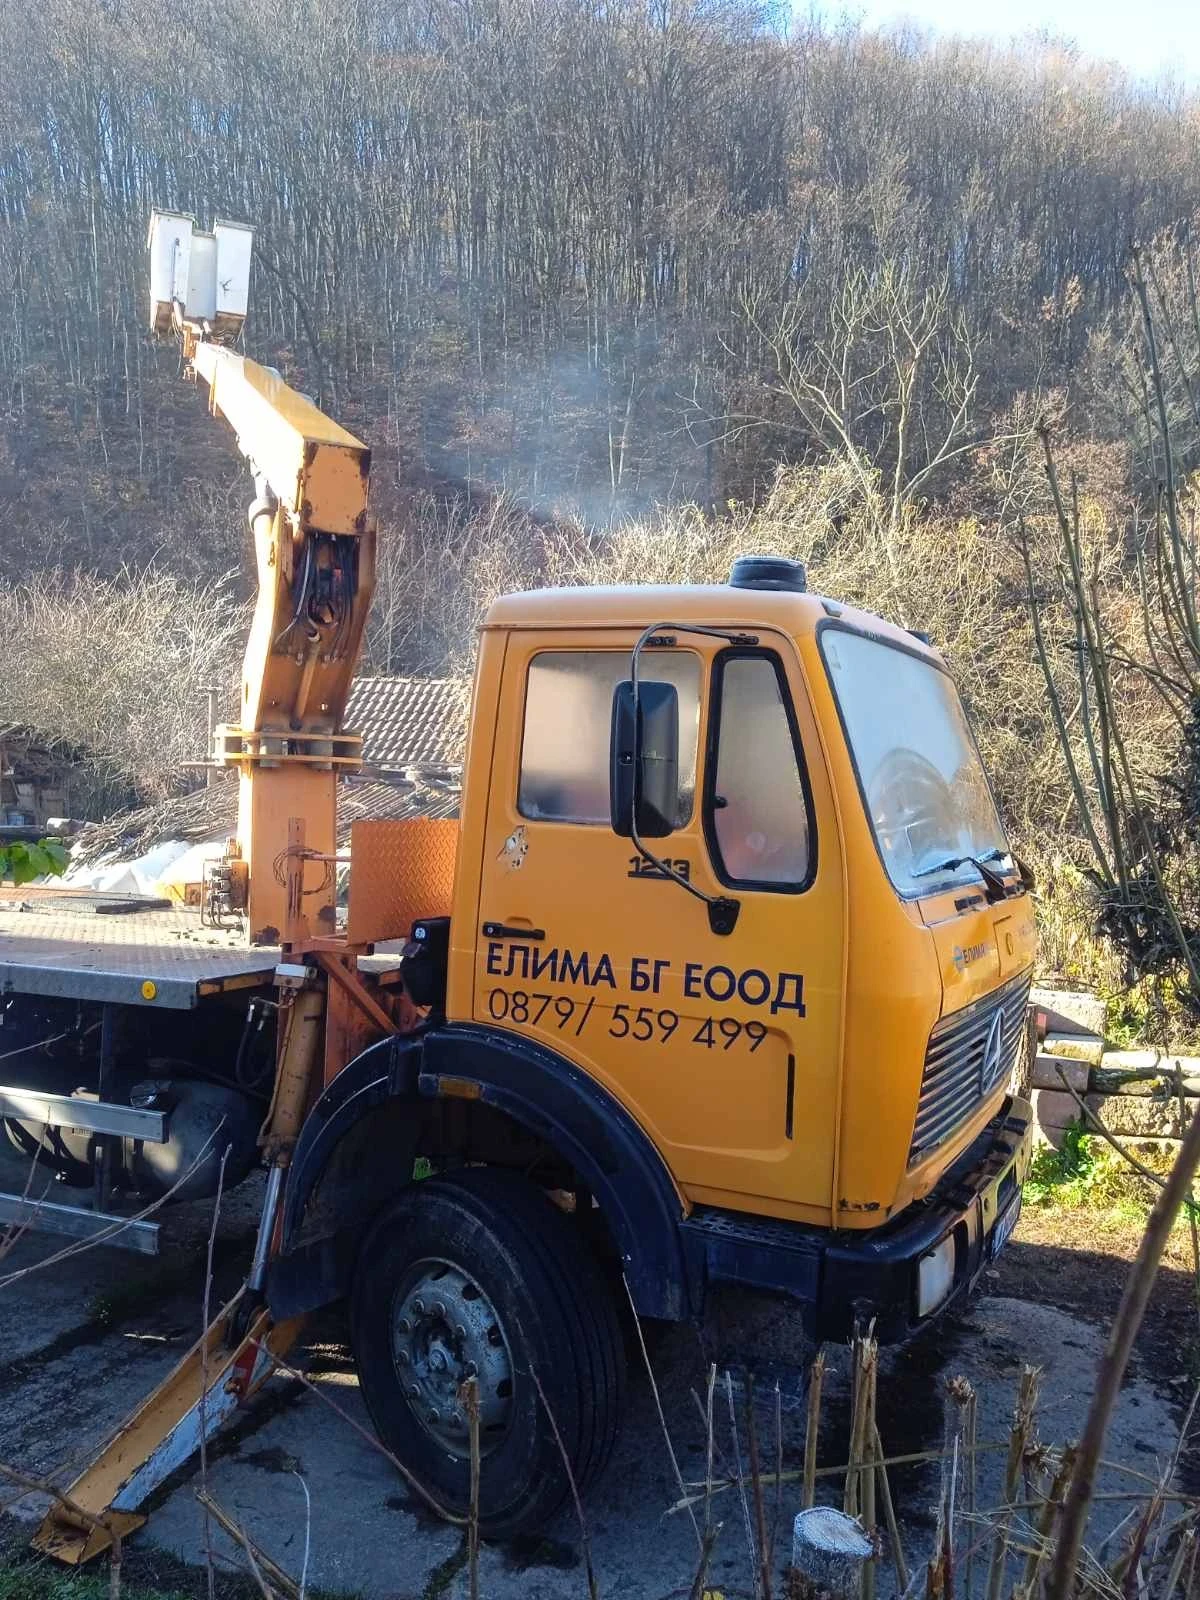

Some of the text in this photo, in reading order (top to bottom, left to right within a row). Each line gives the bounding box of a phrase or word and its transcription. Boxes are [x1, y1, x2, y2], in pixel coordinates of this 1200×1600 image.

[486, 942, 806, 1018] ЕЛИМА БГ ЕООД
[488, 988, 769, 1053] 0879/ 559 499
